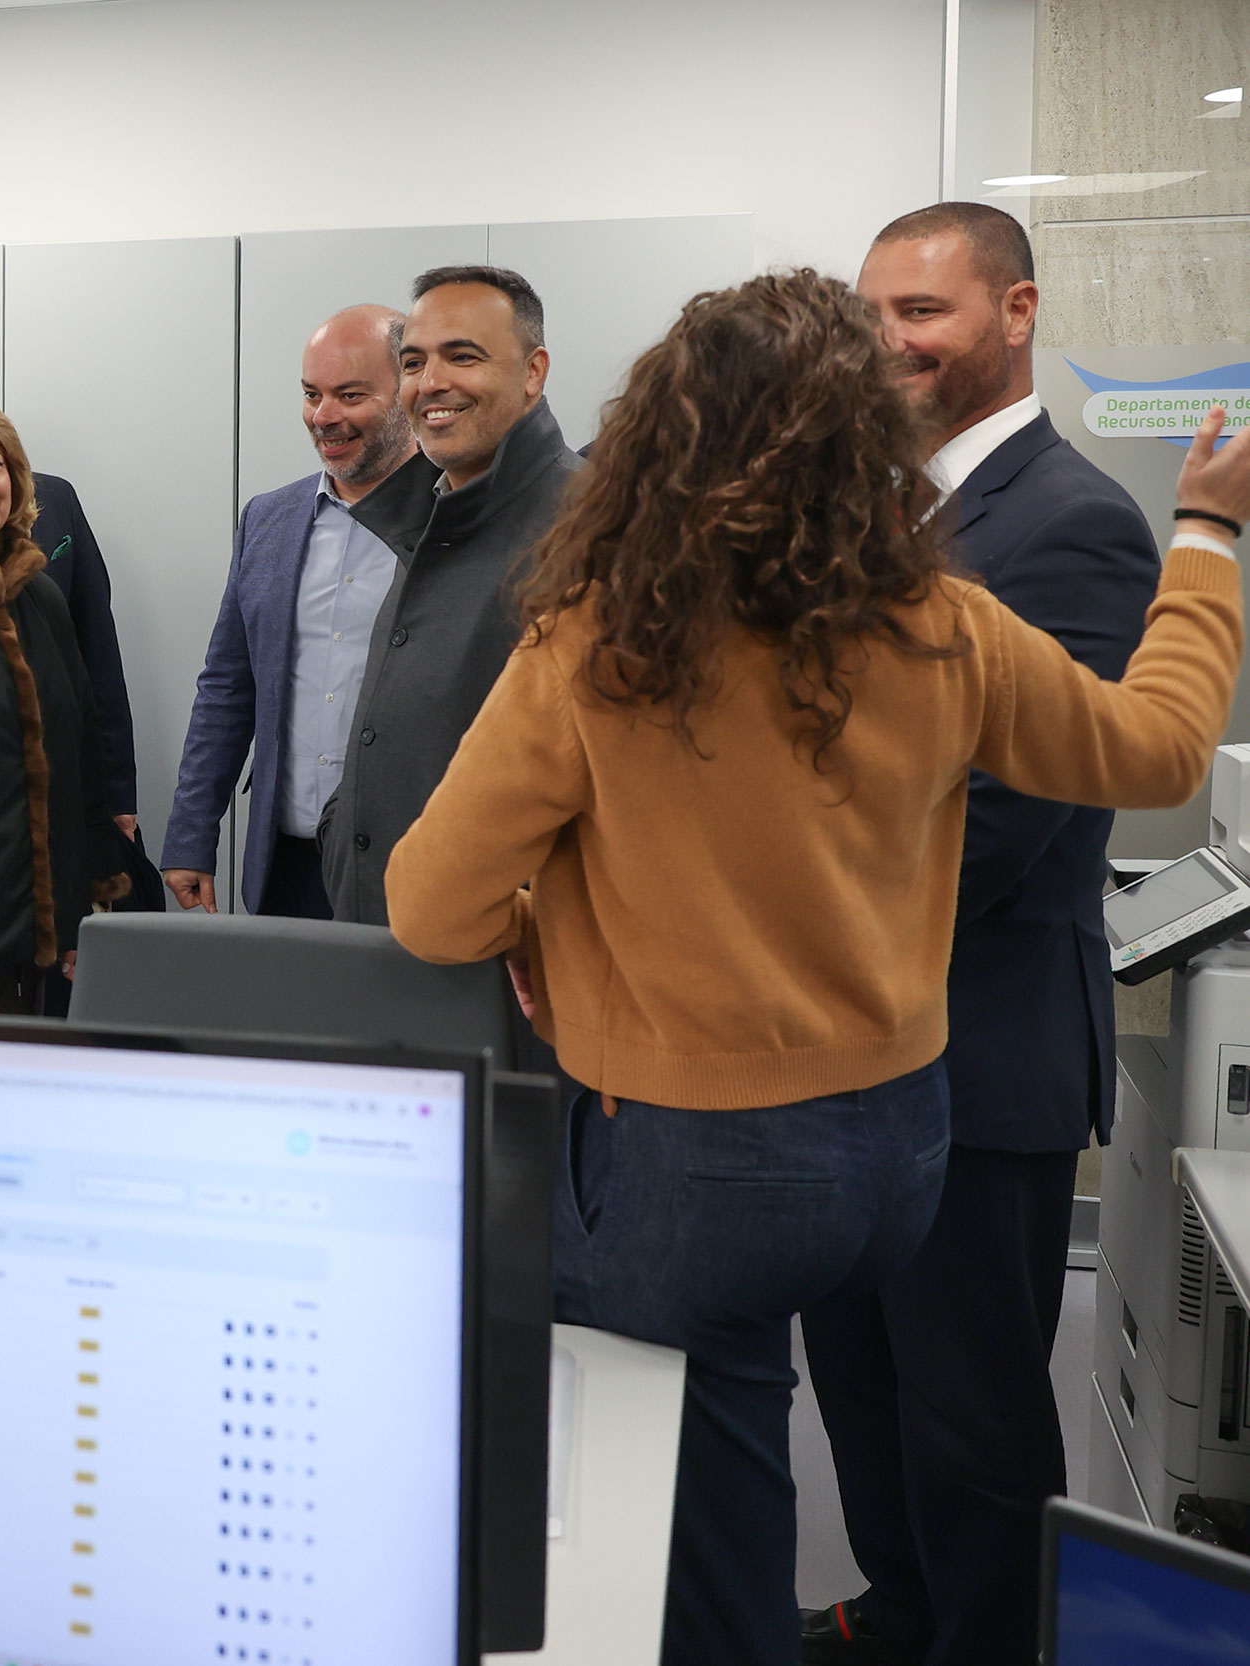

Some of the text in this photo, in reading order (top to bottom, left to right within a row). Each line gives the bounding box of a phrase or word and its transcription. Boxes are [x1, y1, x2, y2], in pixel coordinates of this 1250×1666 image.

[1106, 397, 1229, 414] Departamento
[1097, 414, 1250, 429] Recursos Huano
